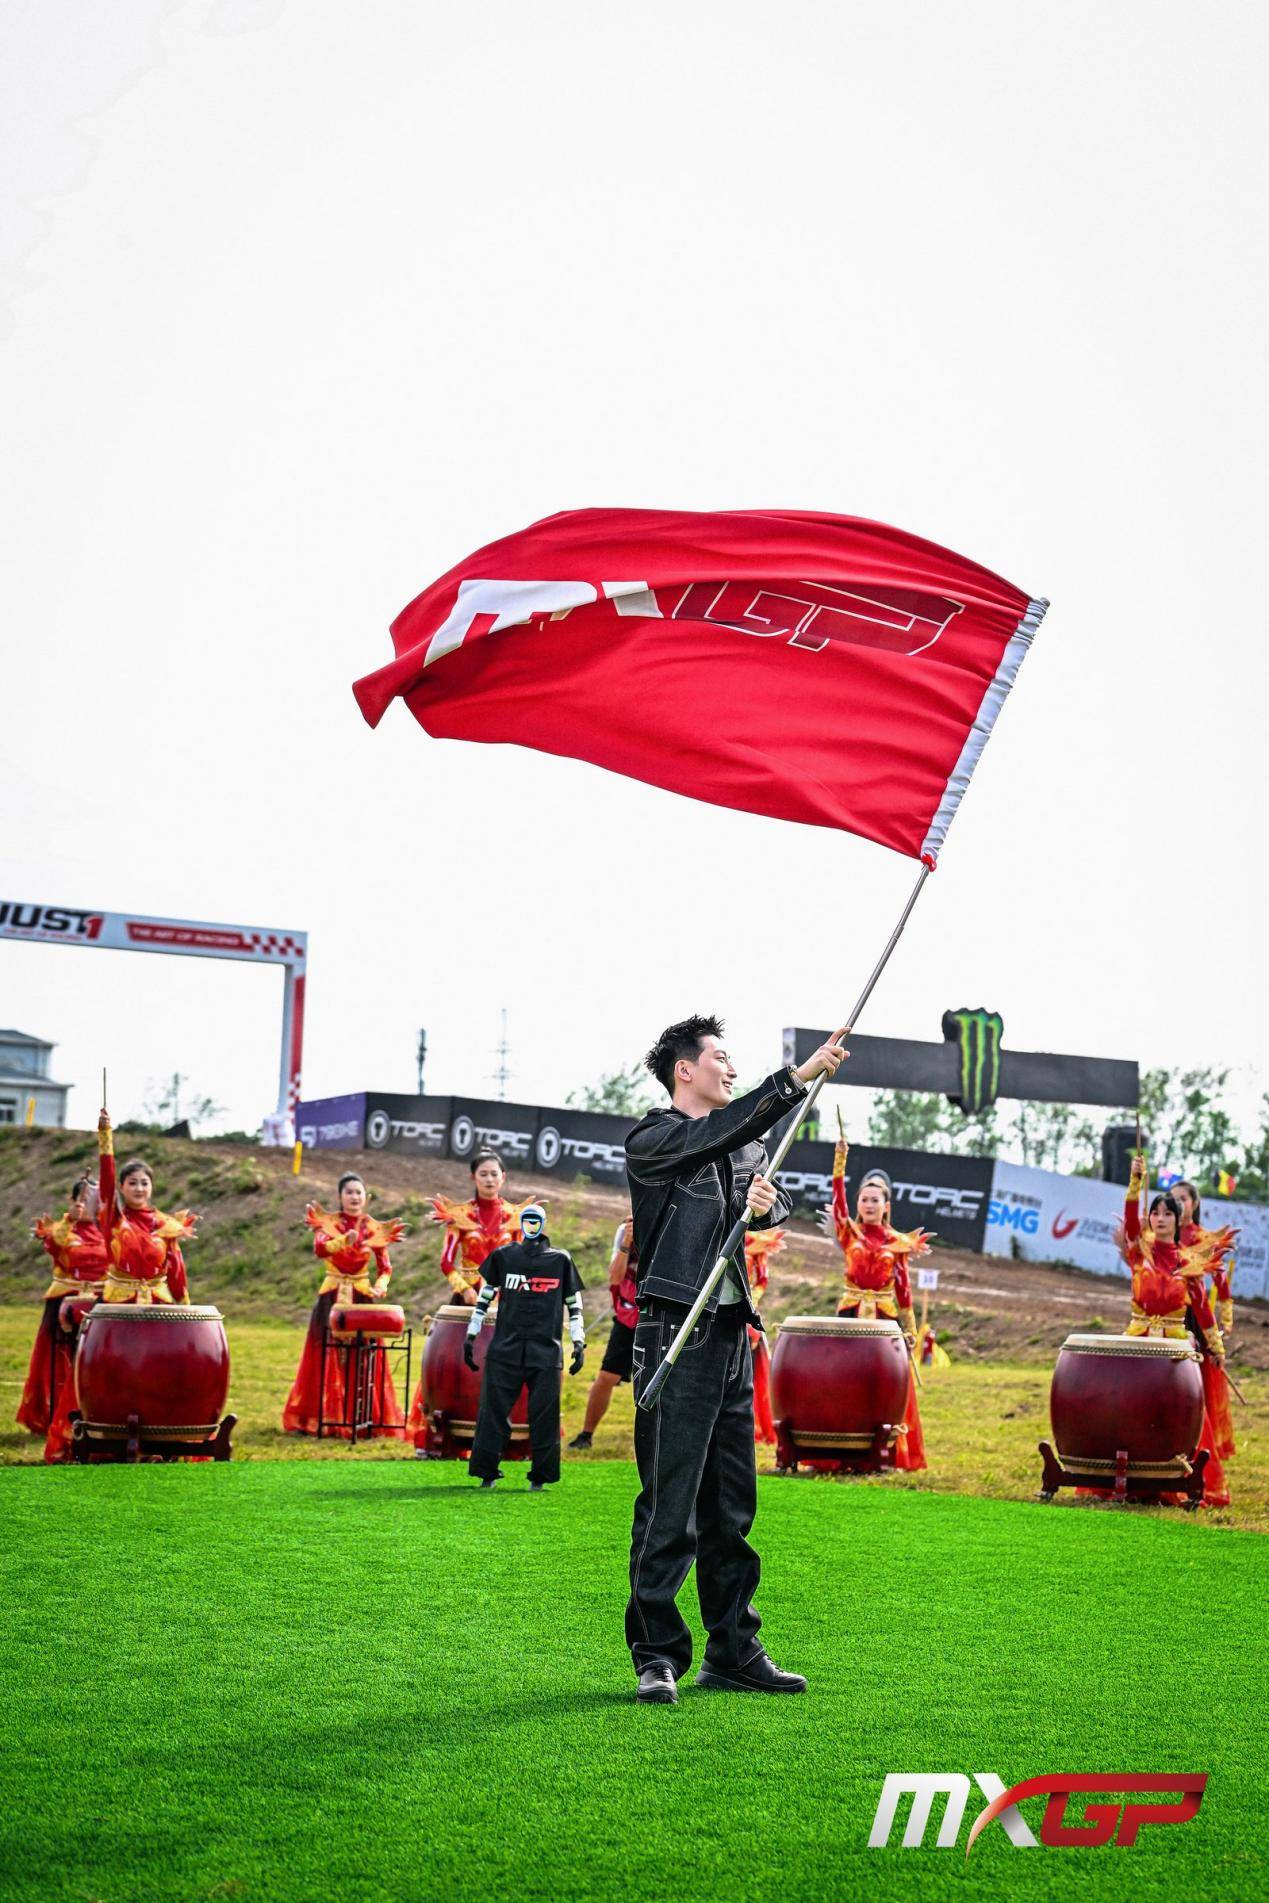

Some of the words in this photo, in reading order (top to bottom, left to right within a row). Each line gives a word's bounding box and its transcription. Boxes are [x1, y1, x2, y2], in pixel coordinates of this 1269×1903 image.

[391, 1120, 446, 1138] TORC
[474, 1126, 532, 1149] TORC
[560, 1138, 627, 1162] TORC
[892, 1182, 984, 1210] TORC
[986, 1200, 1040, 1234] SMG
[505, 1273, 561, 1293] MXGP
